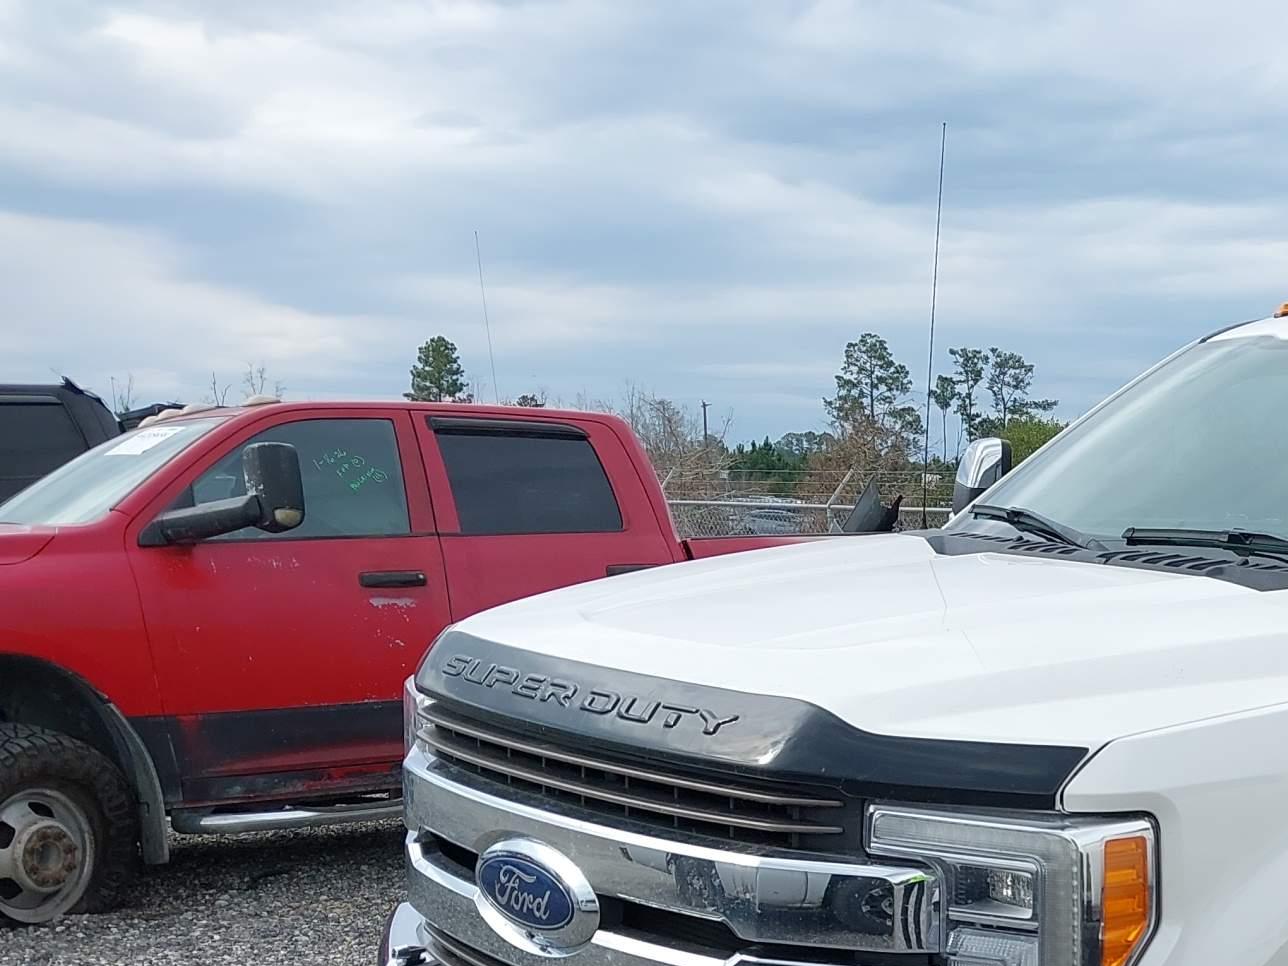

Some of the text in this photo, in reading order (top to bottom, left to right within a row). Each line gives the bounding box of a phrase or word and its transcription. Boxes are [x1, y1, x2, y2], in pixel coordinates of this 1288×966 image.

[441, 653, 741, 736] SUPER DUTY
[495, 863, 551, 920] Ford
